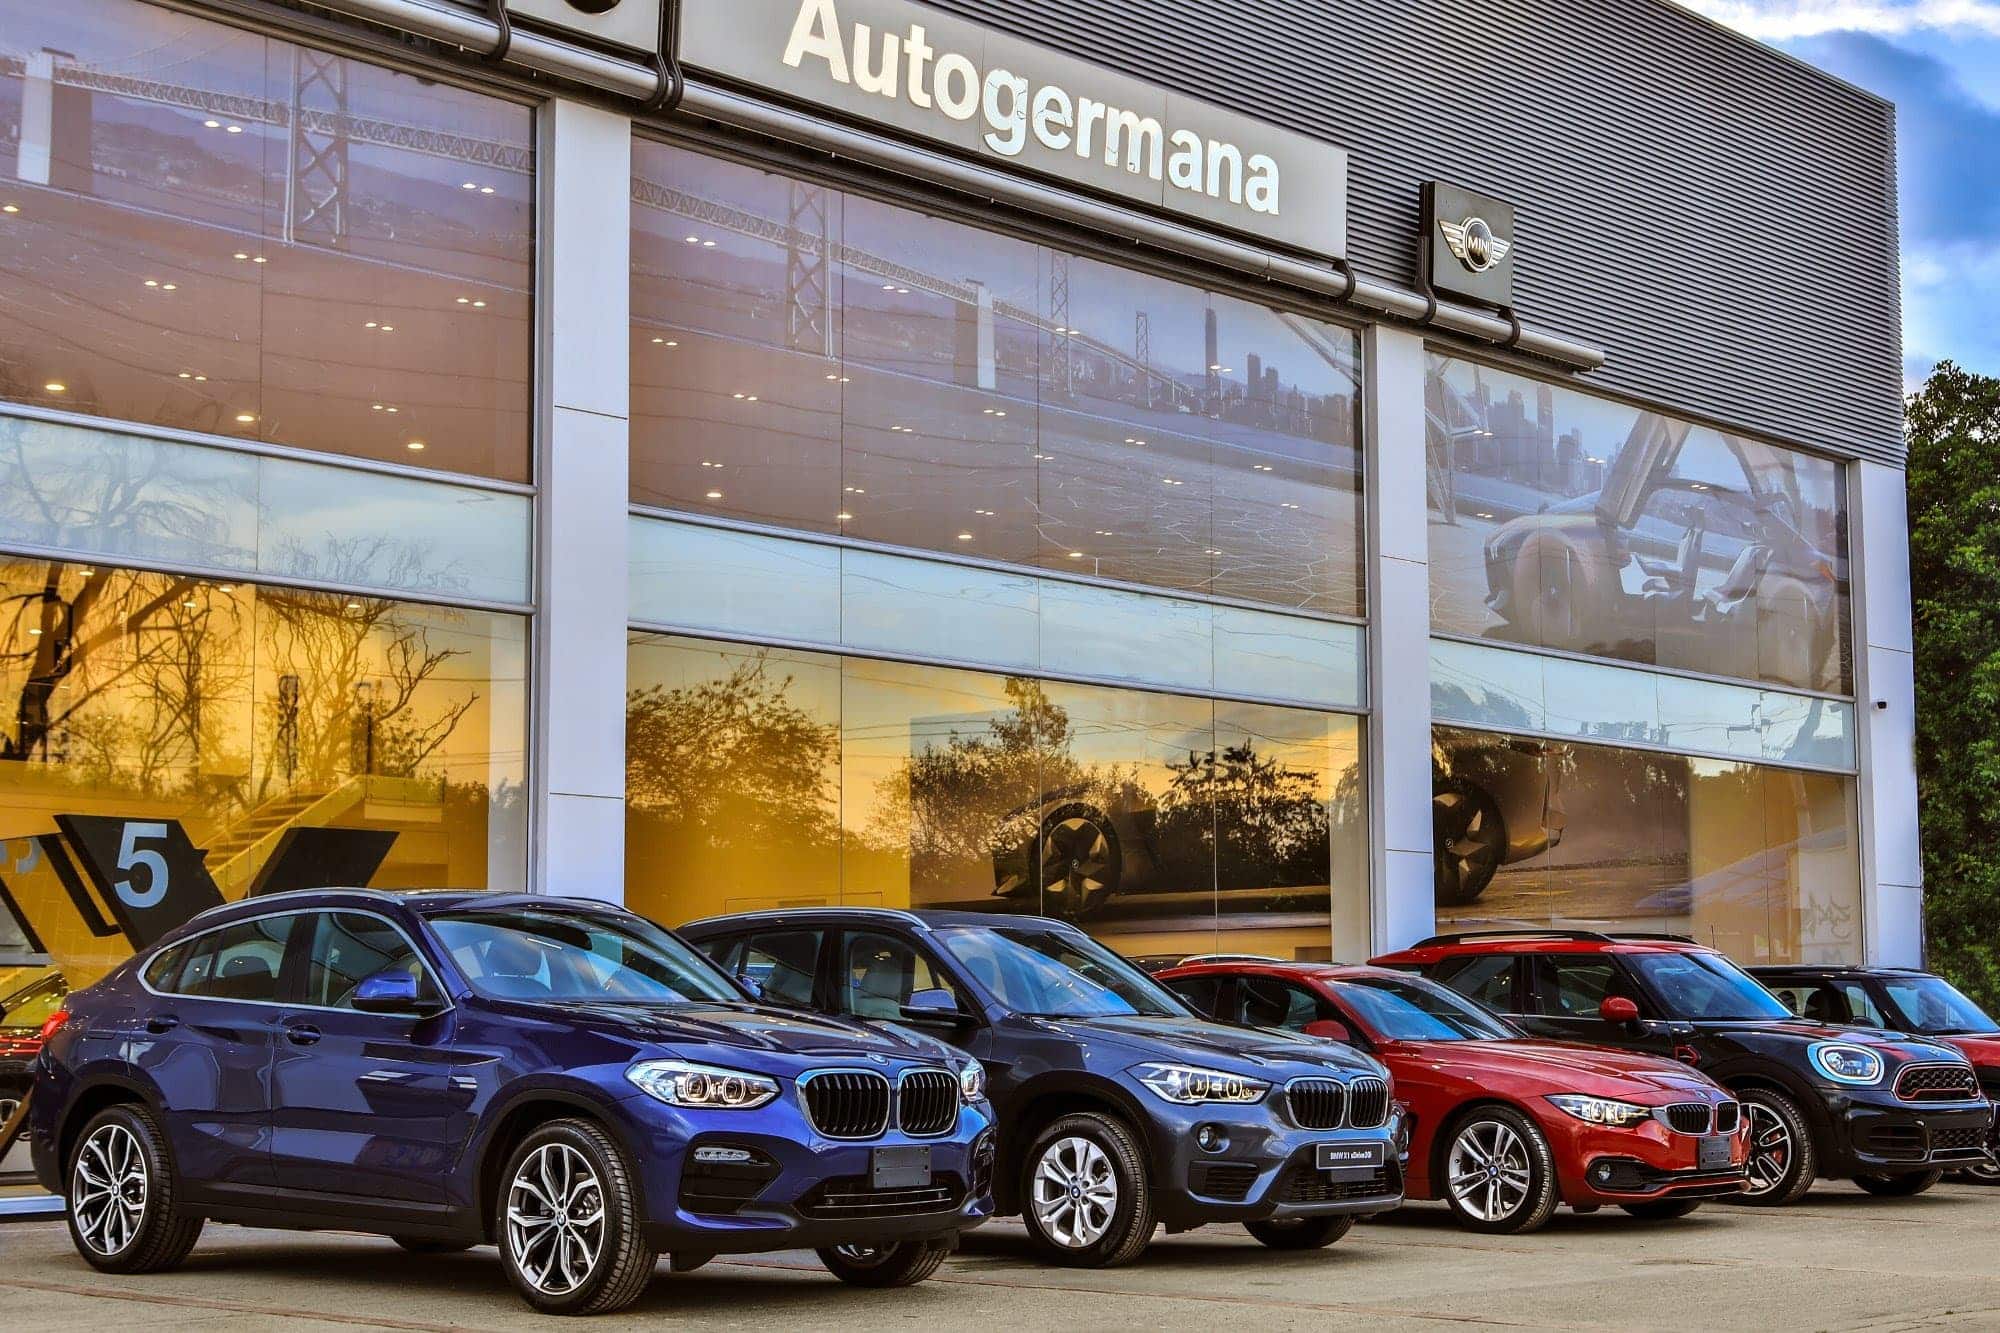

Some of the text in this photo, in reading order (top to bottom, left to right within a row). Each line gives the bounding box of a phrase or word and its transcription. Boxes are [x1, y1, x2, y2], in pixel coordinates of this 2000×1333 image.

[782, 0, 1280, 216] Autogermana
[1468, 235, 1491, 253] MINI
[114, 822, 169, 908] 5
